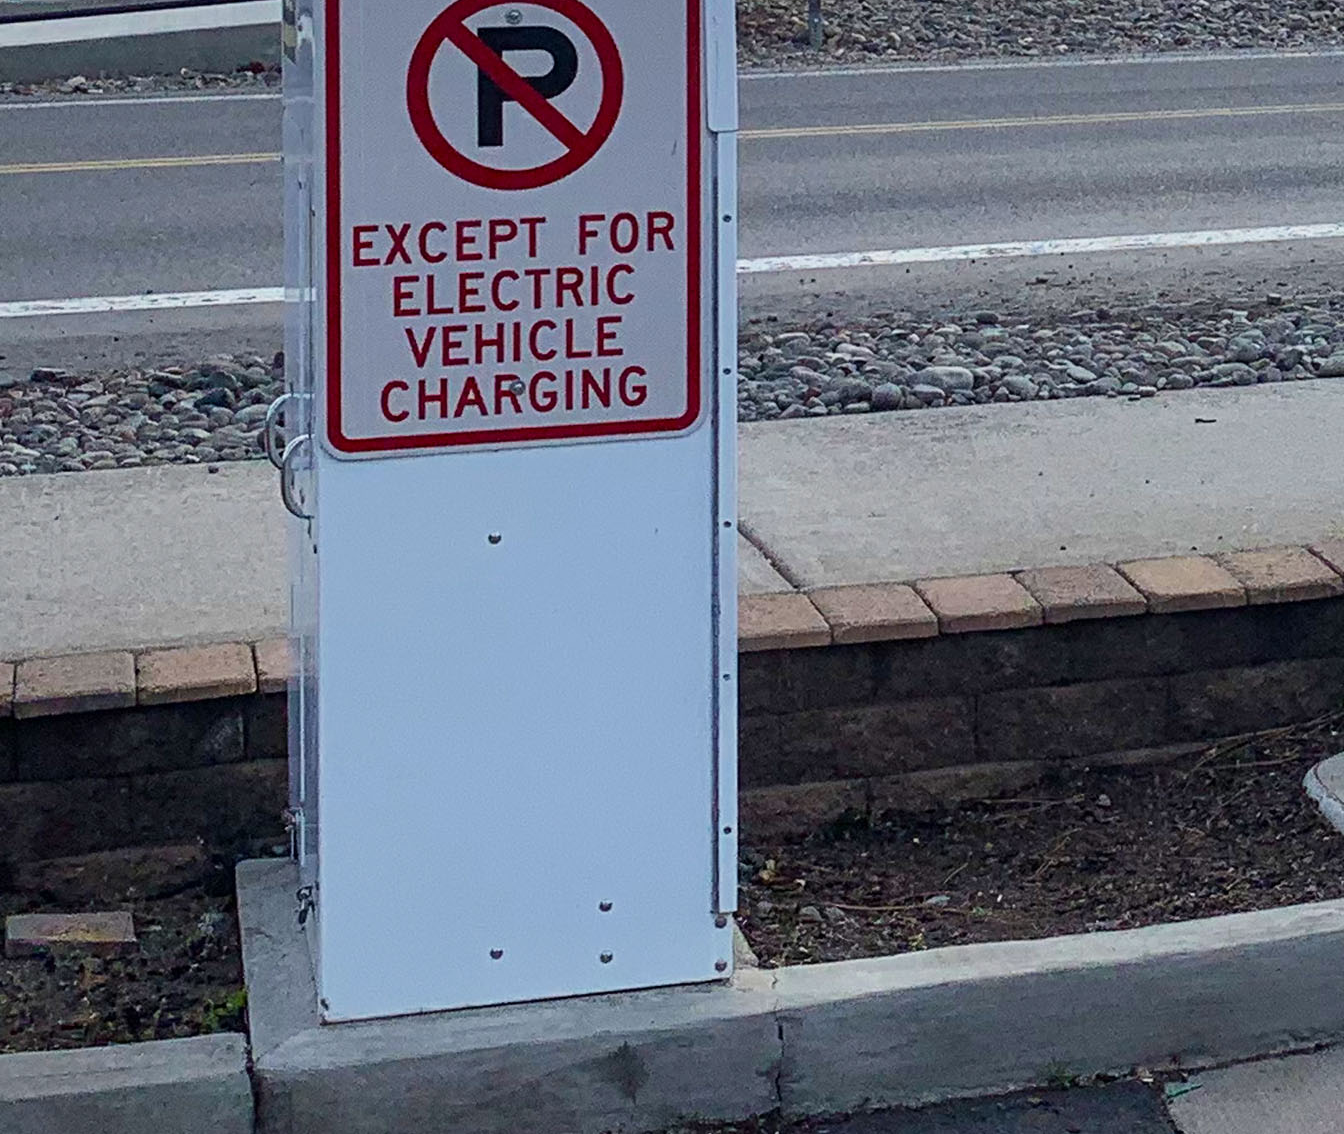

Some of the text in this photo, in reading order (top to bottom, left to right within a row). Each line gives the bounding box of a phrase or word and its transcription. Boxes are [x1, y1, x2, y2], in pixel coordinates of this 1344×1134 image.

[352, 211, 675, 266] EXCEPT FOR
[393, 264, 635, 317] ELECTRIC
[405, 316, 624, 368] VEHICLE
[381, 366, 648, 422] CHARGING
